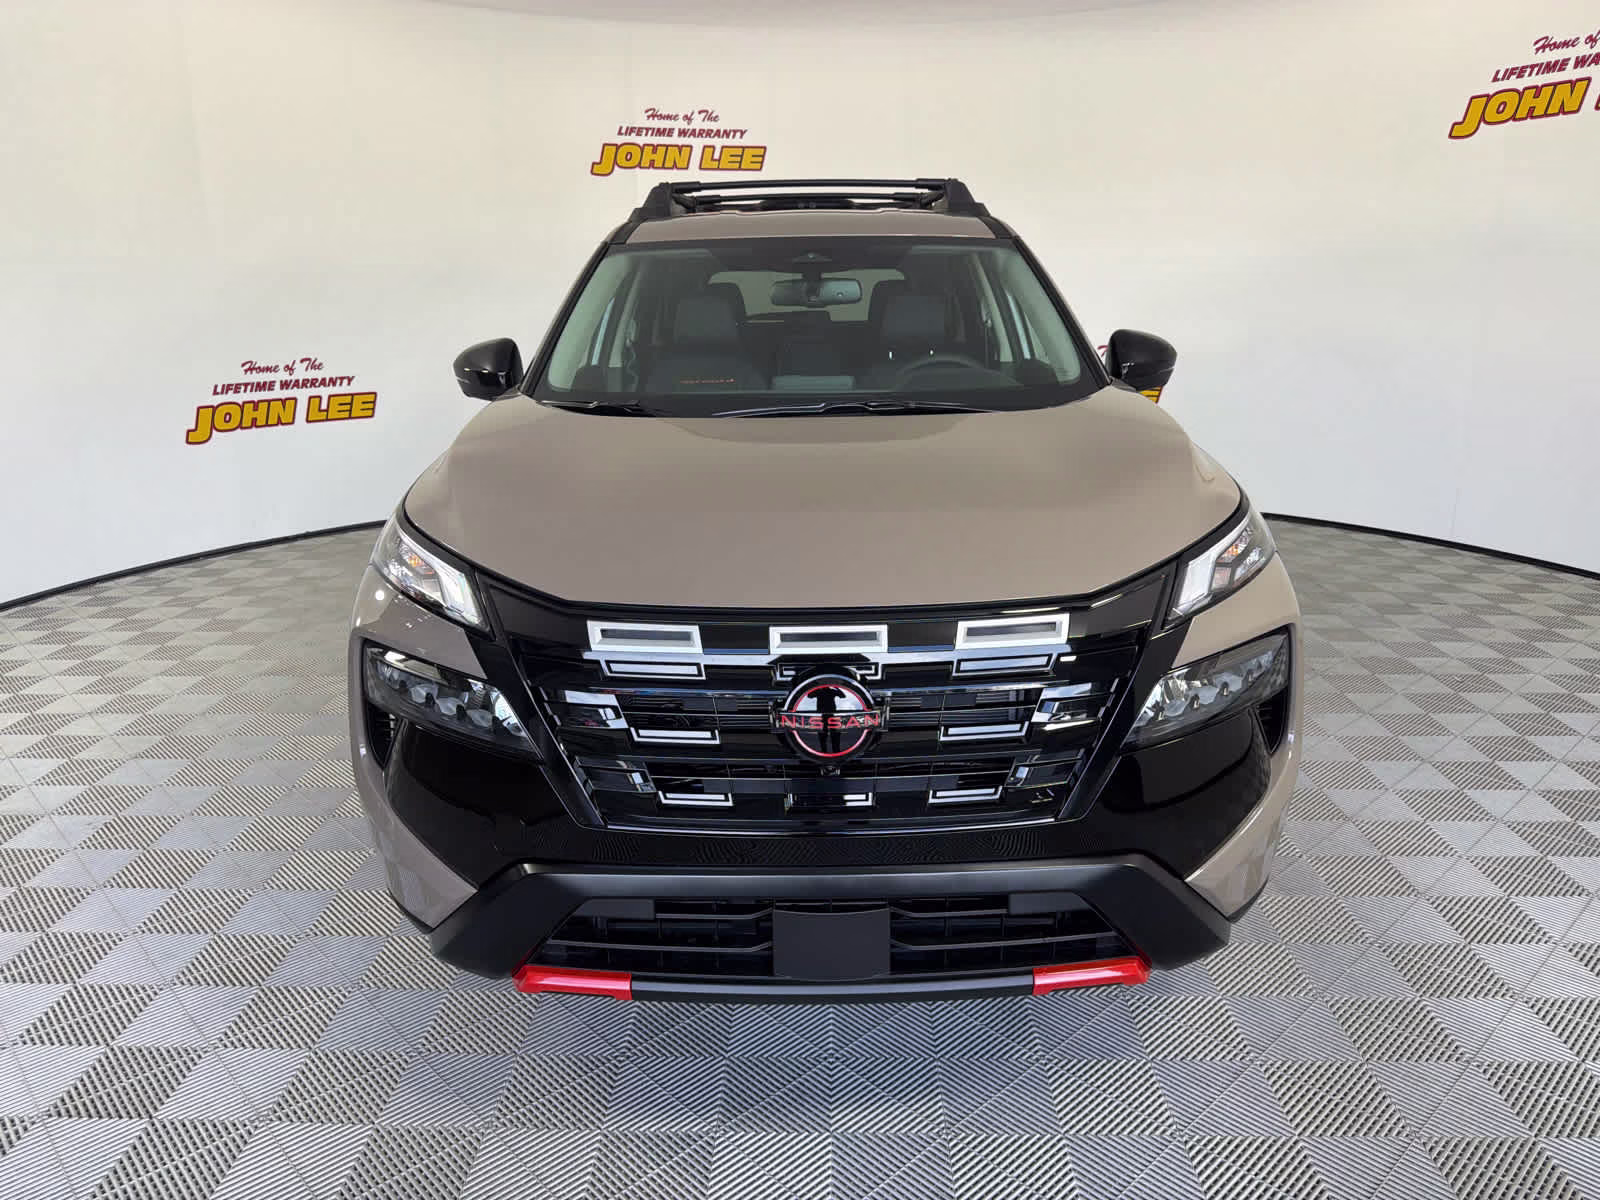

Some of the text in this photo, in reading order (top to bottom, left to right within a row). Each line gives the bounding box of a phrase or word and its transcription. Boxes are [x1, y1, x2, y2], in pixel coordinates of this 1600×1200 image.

[1533, 30, 1600, 55] Home of
[1492, 57, 1571, 83] LIFETIME
[644, 108, 720, 125] Home of The
[1448, 77, 1592, 139] JOHN
[617, 126, 748, 139] LIFETIME WARRANTY
[591, 143, 767, 176] JOHN LEE
[241, 358, 323, 375] Home of The
[212, 376, 355, 396] LIFETIME WARRANTY
[186, 392, 377, 444] JOHN LEE
[780, 713, 879, 729] NISSAN
